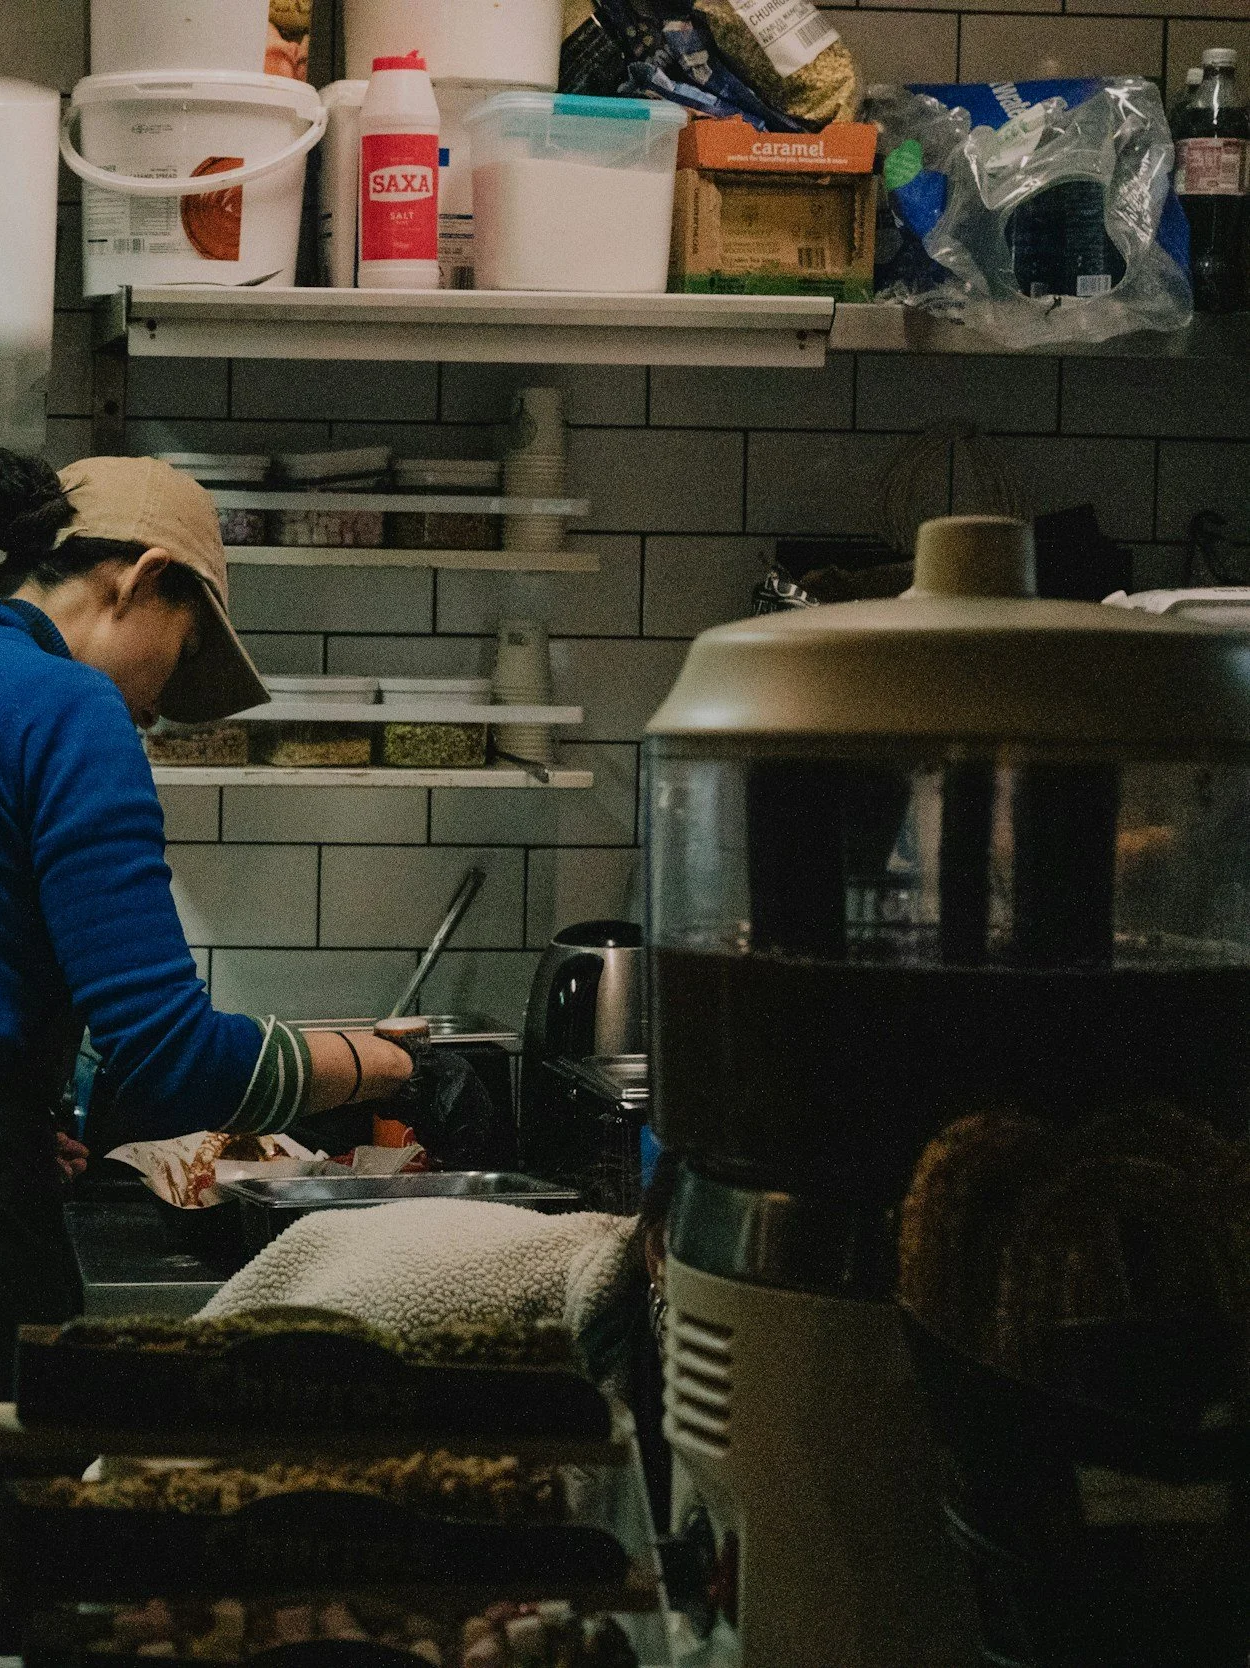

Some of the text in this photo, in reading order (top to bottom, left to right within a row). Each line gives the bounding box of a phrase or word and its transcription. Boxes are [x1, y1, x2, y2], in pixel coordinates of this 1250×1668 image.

[748, 0, 790, 26] CHURR
[752, 141, 826, 157] caramel
[372, 173, 431, 194] SAXA
[390, 211, 414, 220] SALT
